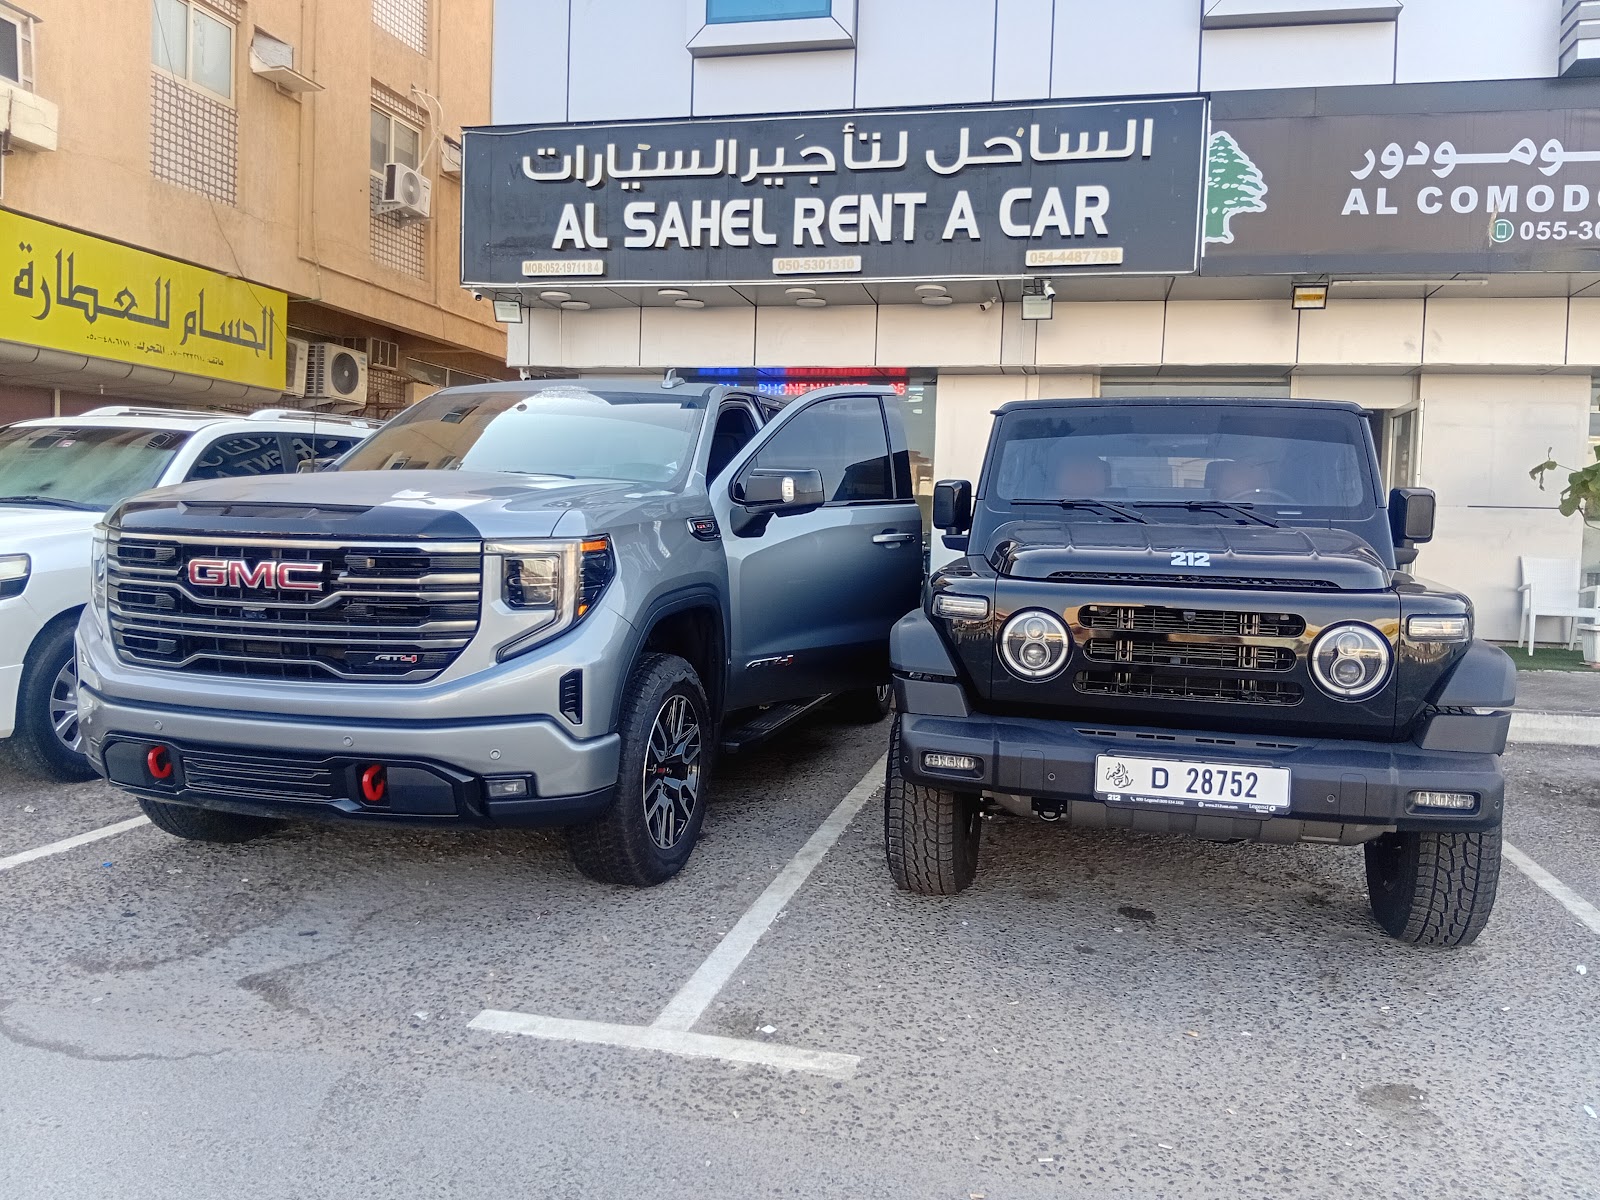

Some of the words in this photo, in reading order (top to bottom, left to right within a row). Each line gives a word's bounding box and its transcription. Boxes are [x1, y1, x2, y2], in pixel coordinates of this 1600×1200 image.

[522, 139, 737, 190] السيارات
[740, 122, 908, 186] لتأجير
[925, 118, 1154, 175] الساحل
[1350, 138, 1600, 180] ومودور
[552, 202, 608, 249] AL
[624, 198, 777, 248] SAHEL
[793, 193, 927, 246] RENT
[942, 190, 980, 241] A
[1000, 185, 1110, 238] CAR
[1341, 187, 1398, 215] AL
[1416, 184, 1600, 214] COMOD
[777, 257, 855, 272] 050-5301310
[1029, 249, 1119, 264] 054-4487799
[13, 241, 171, 329] للعطارة
[180, 288, 275, 360] الحسام
[188, 558, 324, 591] GMC
[1170, 551, 1210, 567] 212
[1107, 793, 1121, 802] 212
[1151, 766, 1169, 789] D
[1186, 767, 1259, 798] 28752
